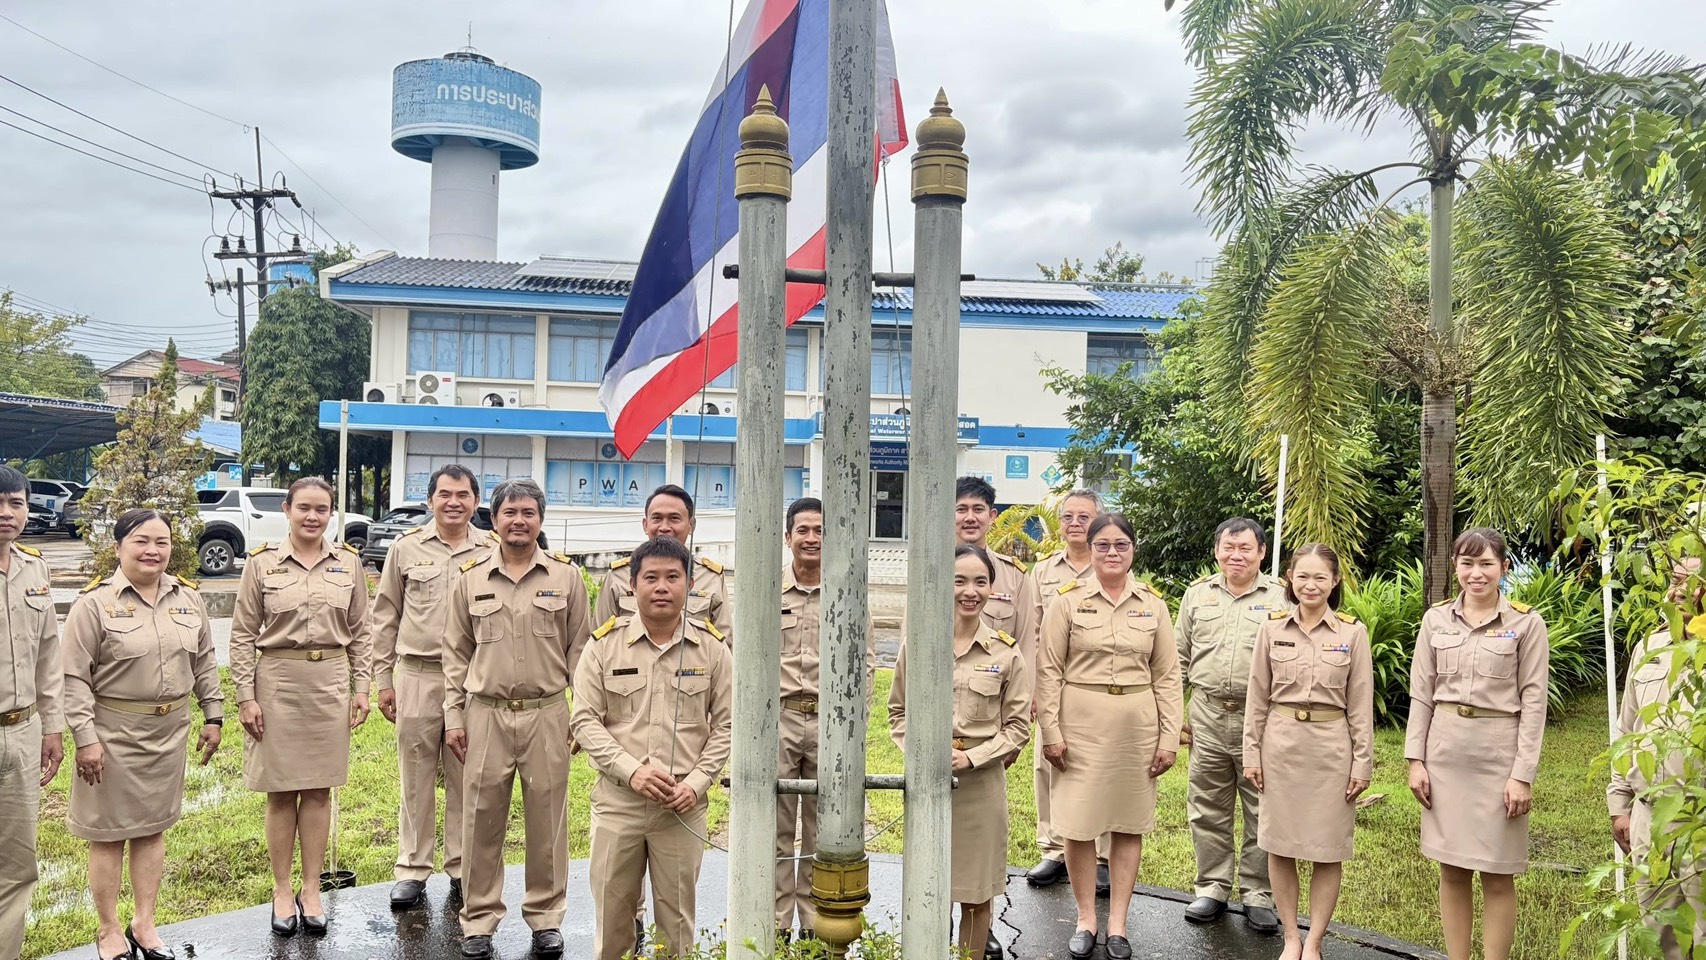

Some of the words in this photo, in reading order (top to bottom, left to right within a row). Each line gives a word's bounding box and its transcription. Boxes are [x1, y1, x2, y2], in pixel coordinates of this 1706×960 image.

[437, 83, 539, 121] การประปาส่ว
[579, 479, 588, 490] P
[601, 479, 616, 490] W
[628, 480, 639, 491] A
